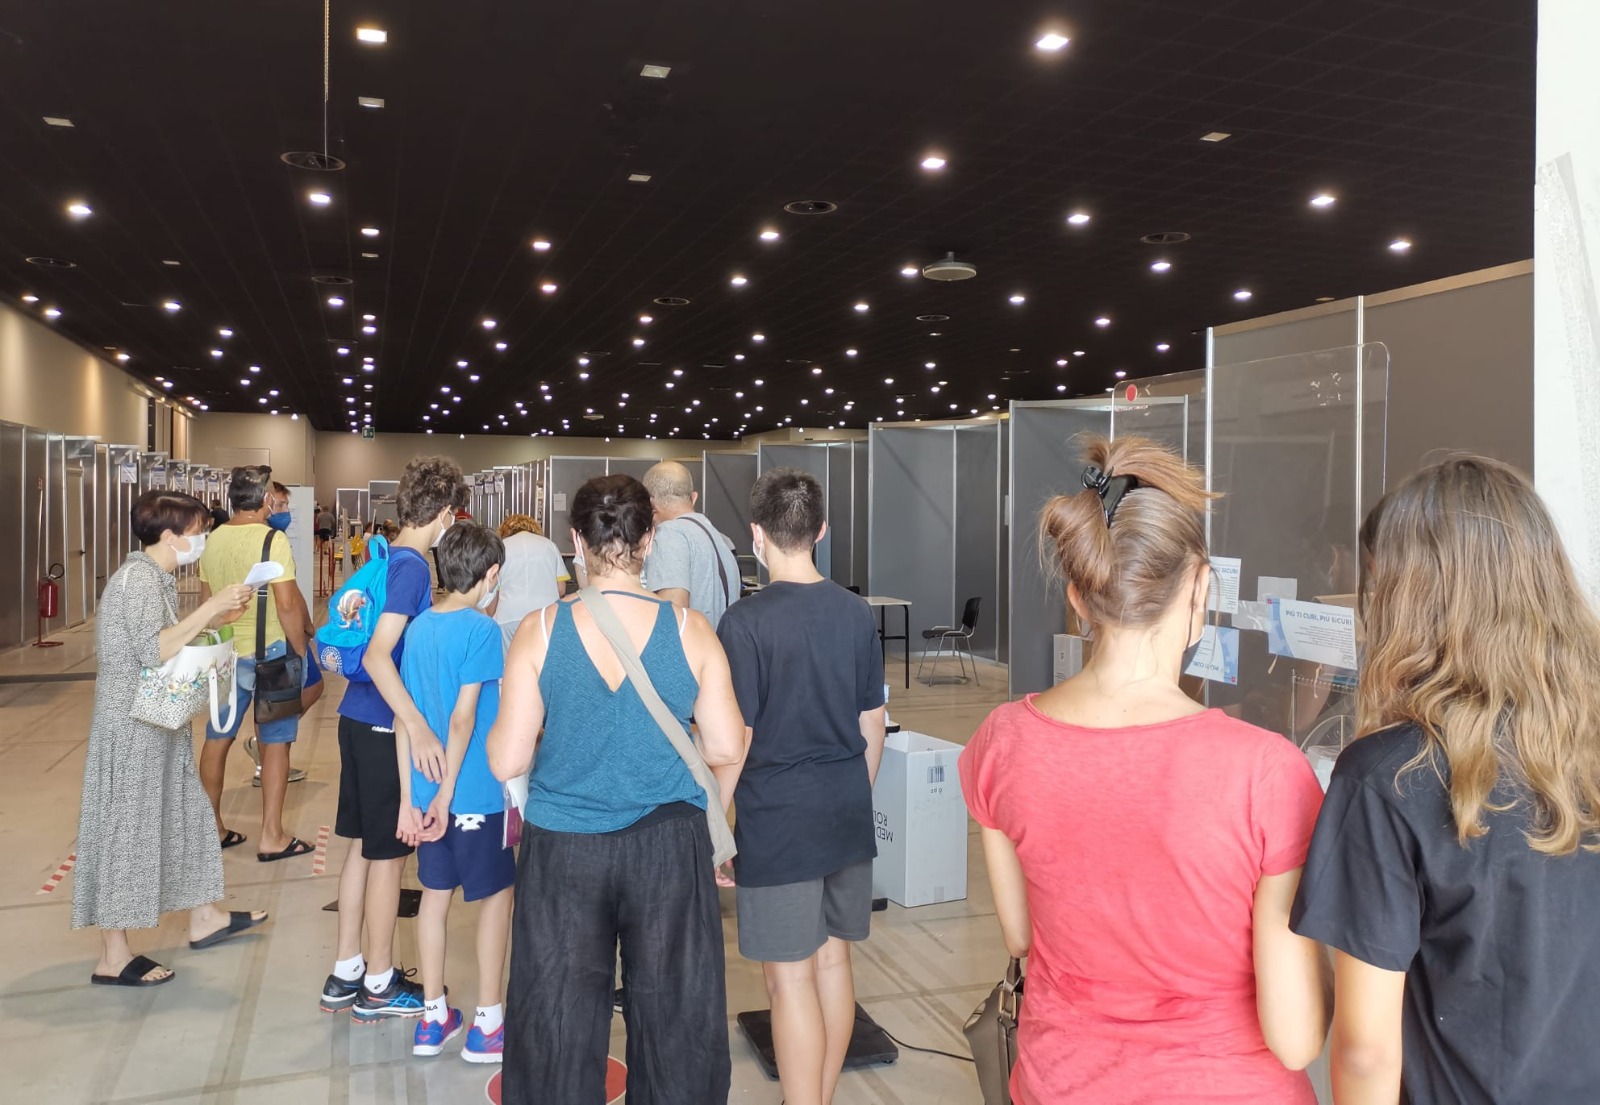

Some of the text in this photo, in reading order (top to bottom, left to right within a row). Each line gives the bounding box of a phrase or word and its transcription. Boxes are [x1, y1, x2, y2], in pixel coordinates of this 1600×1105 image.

[125, 450, 133, 463] 1
[154, 456, 163, 467] 2
[176, 463, 185, 474] 3
[196, 468, 204, 476] 4
[210, 471, 218, 480] 5
[1331, 616, 1352, 625] SICURI
